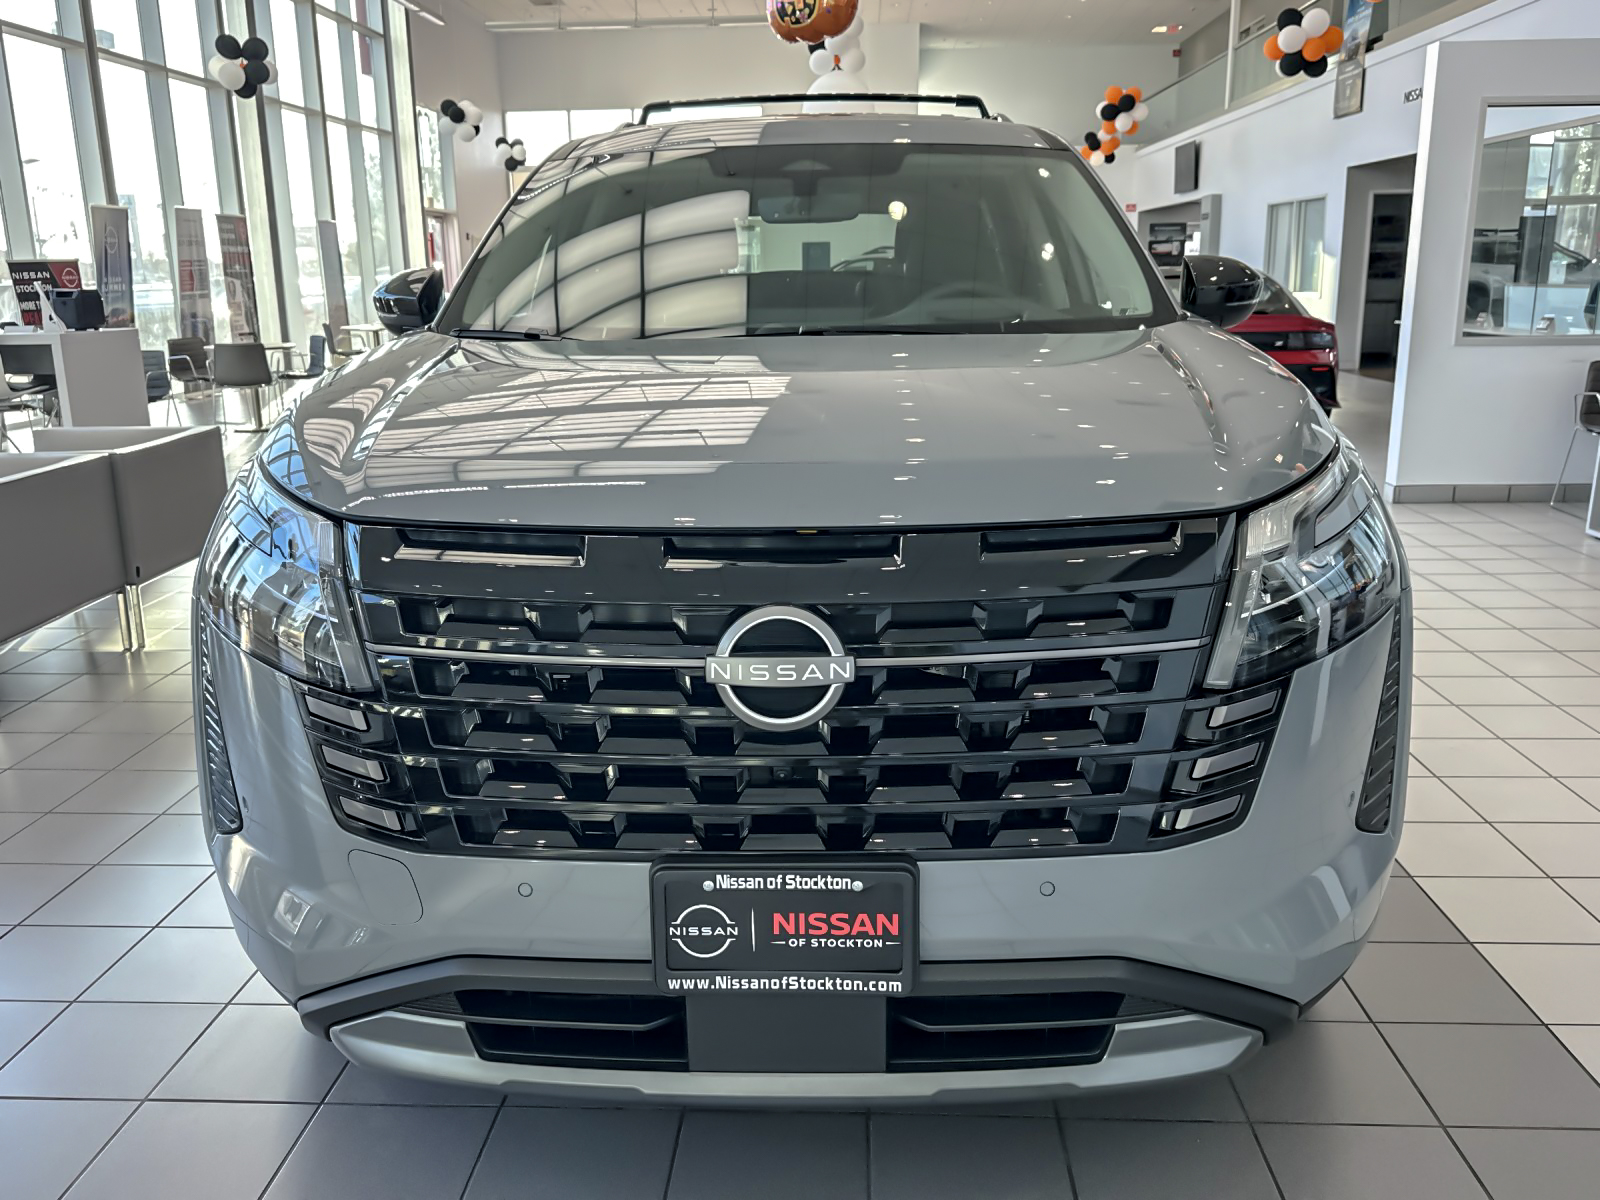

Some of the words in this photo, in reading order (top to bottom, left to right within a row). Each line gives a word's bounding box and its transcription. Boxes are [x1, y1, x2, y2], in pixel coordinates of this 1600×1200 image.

[1403, 87, 1423, 104] NISSA
[12, 271, 50, 279] NISSAN
[15, 283, 52, 293] STOCON
[710, 661, 850, 681] NISSAN
[715, 874, 763, 890] Nissan
[766, 874, 783, 889] of
[785, 874, 852, 890] Stockton
[669, 926, 739, 936] NISSAN
[773, 912, 899, 936] NISSAN
[788, 939, 806, 947] OF
[810, 938, 883, 948] STOCKTON
[667, 975, 902, 993] www.NissanofStockton.com
